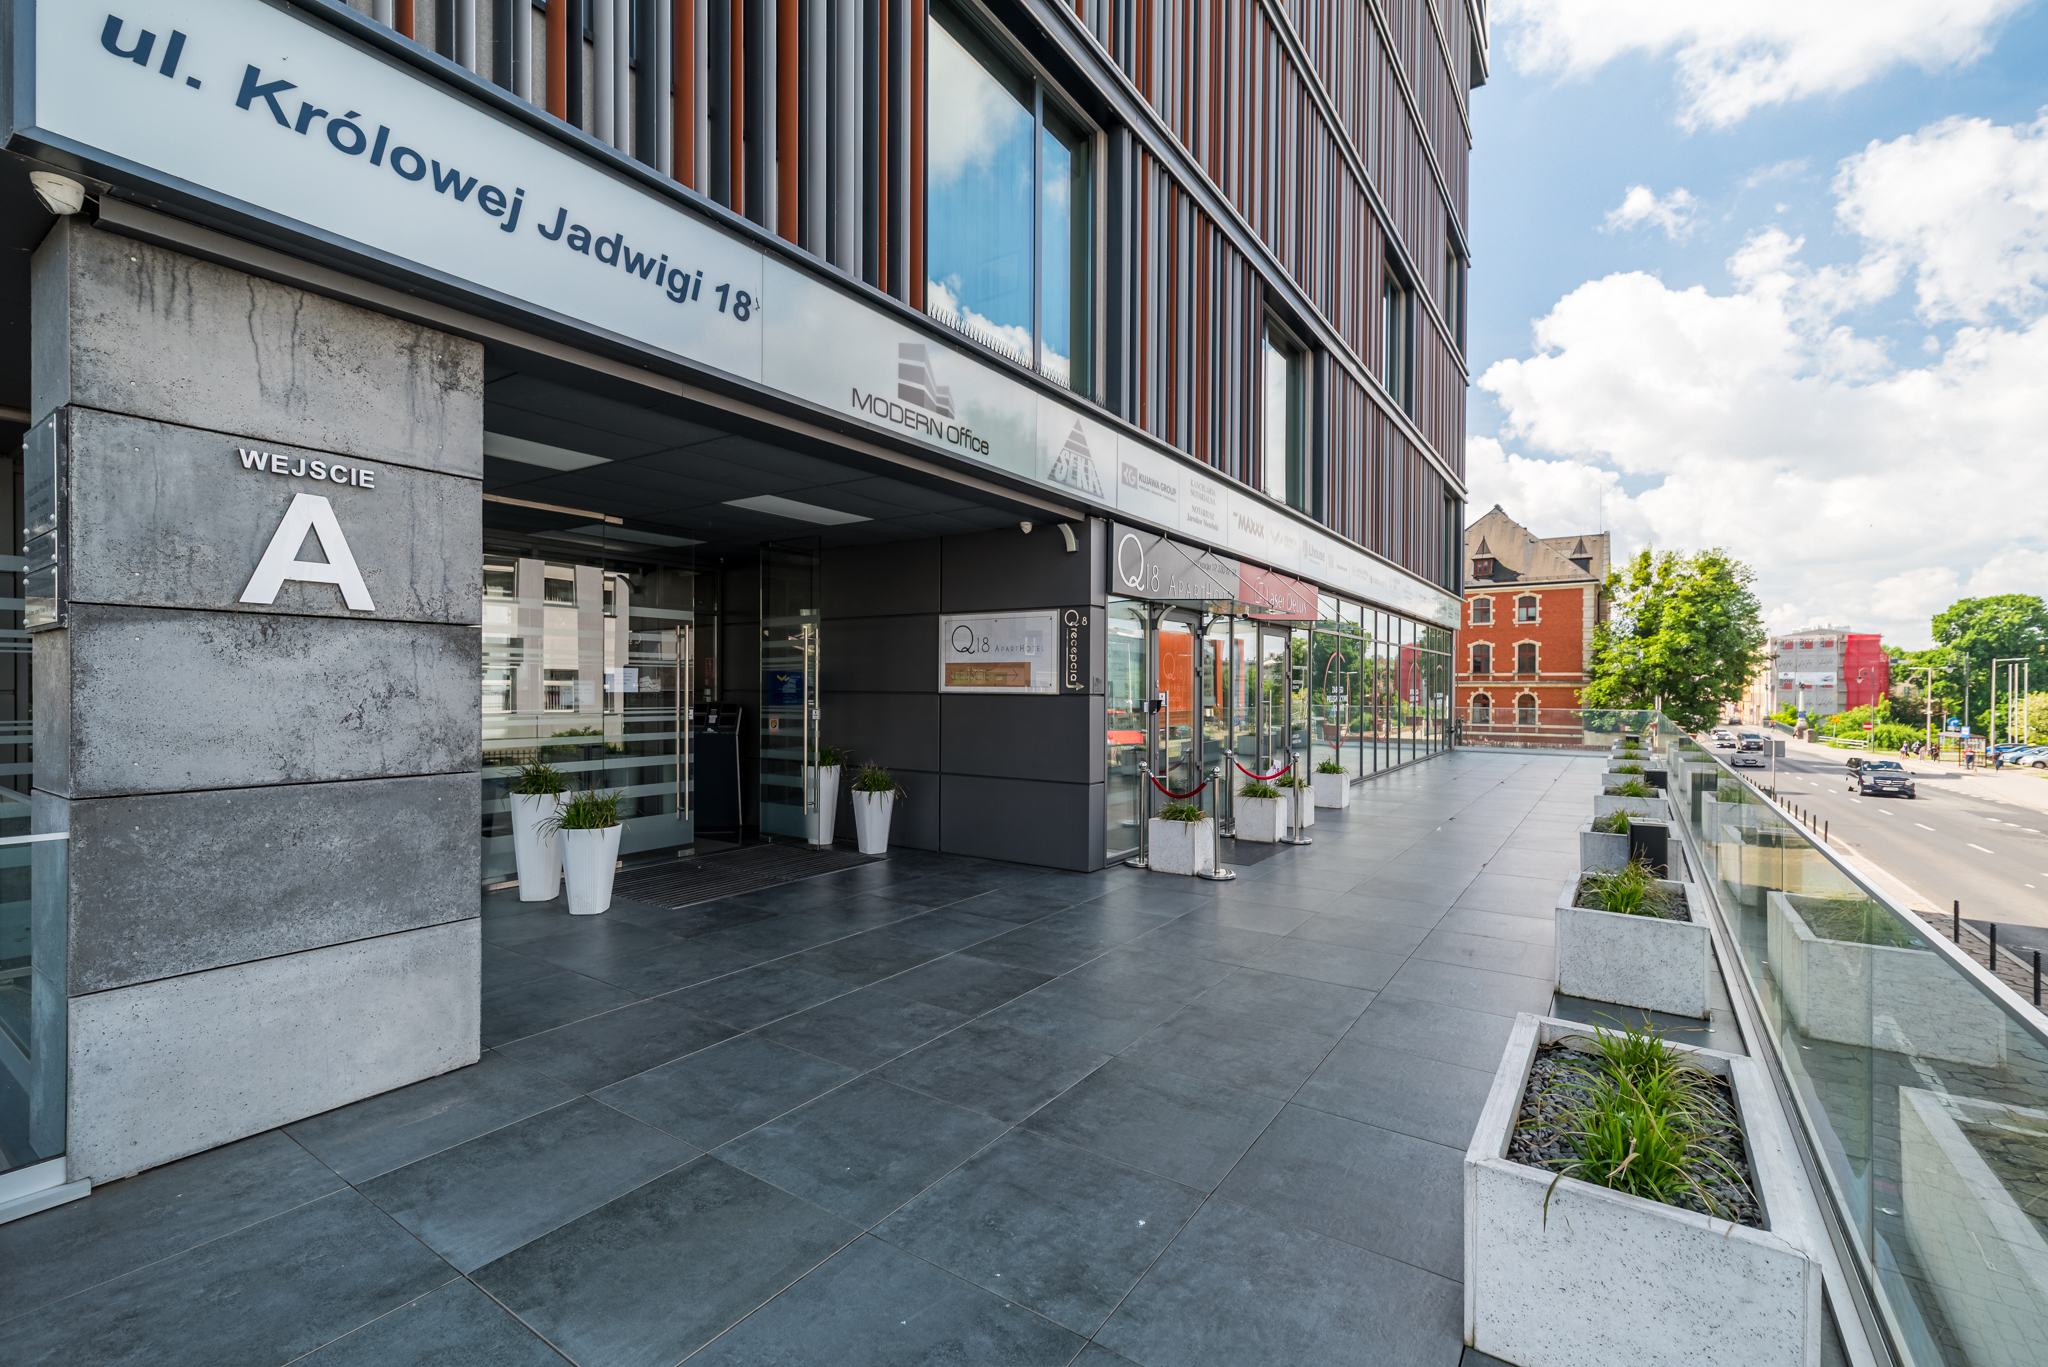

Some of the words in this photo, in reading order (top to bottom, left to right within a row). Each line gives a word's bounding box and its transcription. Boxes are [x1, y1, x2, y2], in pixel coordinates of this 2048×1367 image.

[101, 15, 202, 90] ul.
[235, 63, 525, 233] Królowej
[537, 207, 704, 304] Jadwigi
[714, 282, 752, 322] 18
[852, 387, 943, 439] MODERN
[946, 424, 990, 456] Office
[239, 448, 376, 489] WEJSCIE
[1160, 482, 1177, 496] GROUP
[239, 492, 376, 612] A
